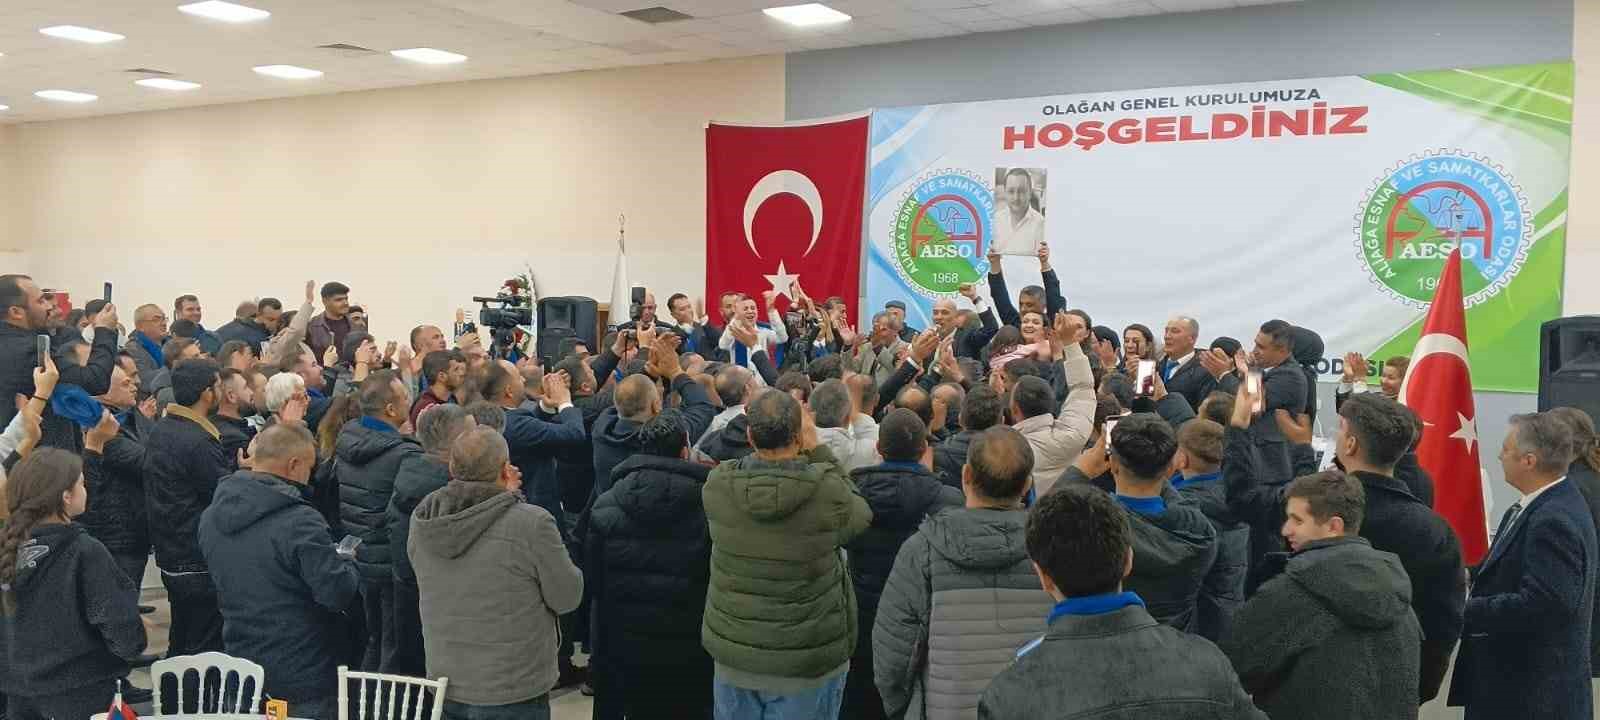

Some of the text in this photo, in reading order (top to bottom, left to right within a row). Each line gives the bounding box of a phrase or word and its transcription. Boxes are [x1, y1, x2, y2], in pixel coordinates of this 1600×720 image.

[1042, 87, 1321, 116] OLAĞAN GENEL KURULUMUZA
[1003, 101, 1368, 151] HOŞGELDİNİZ
[898, 192, 920, 230] ESNAF
[921, 181, 937, 194] VE
[1367, 180, 1401, 225] ESNAF
[1401, 167, 1424, 181] VE
[1427, 161, 1517, 231] SANATKARLAR
[1480, 235, 1516, 281] ODASI
[919, 244, 972, 258] AESO
[1398, 242, 1477, 259] AESO
[932, 272, 959, 284] 1968
[1315, 357, 1385, 377] ODSI
